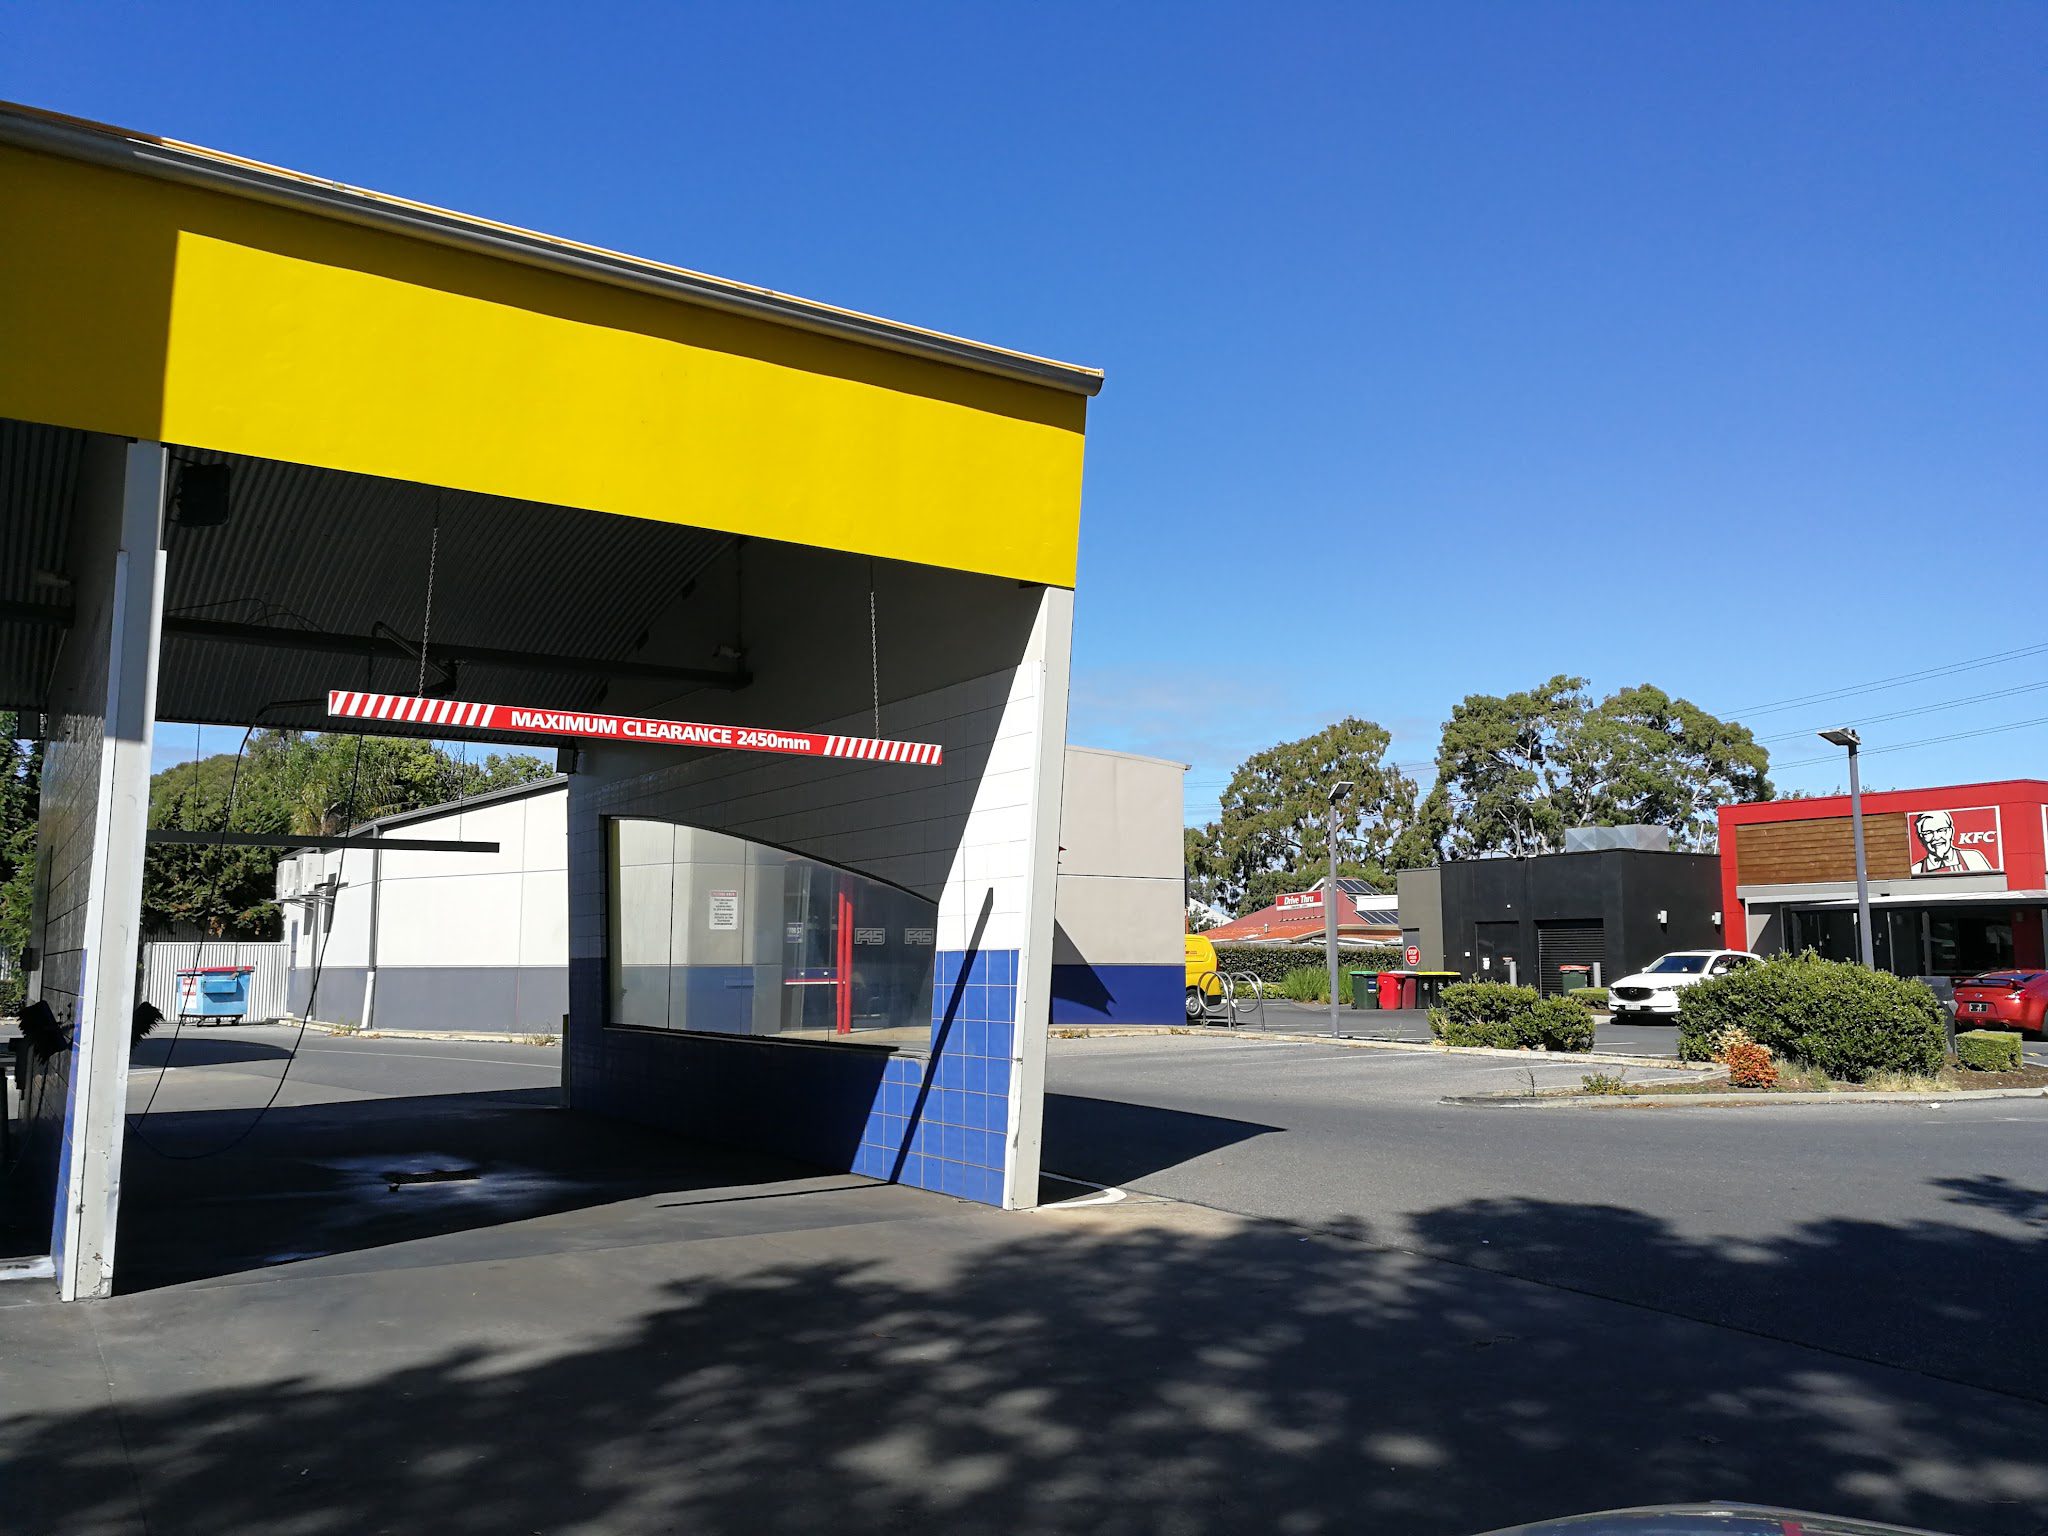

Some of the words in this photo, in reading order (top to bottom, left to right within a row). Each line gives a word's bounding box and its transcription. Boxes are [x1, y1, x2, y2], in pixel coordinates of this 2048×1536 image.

[511, 711, 617, 734] MAXIMUM
[622, 721, 732, 744] CLEARANCE
[737, 731, 811, 751] 2450mm
[1958, 831, 1996, 845] KFC
[1284, 896, 1300, 905] Drive
[1300, 894, 1314, 904] Thru
[856, 929, 884, 944] F45
[906, 929, 933, 944] F45
